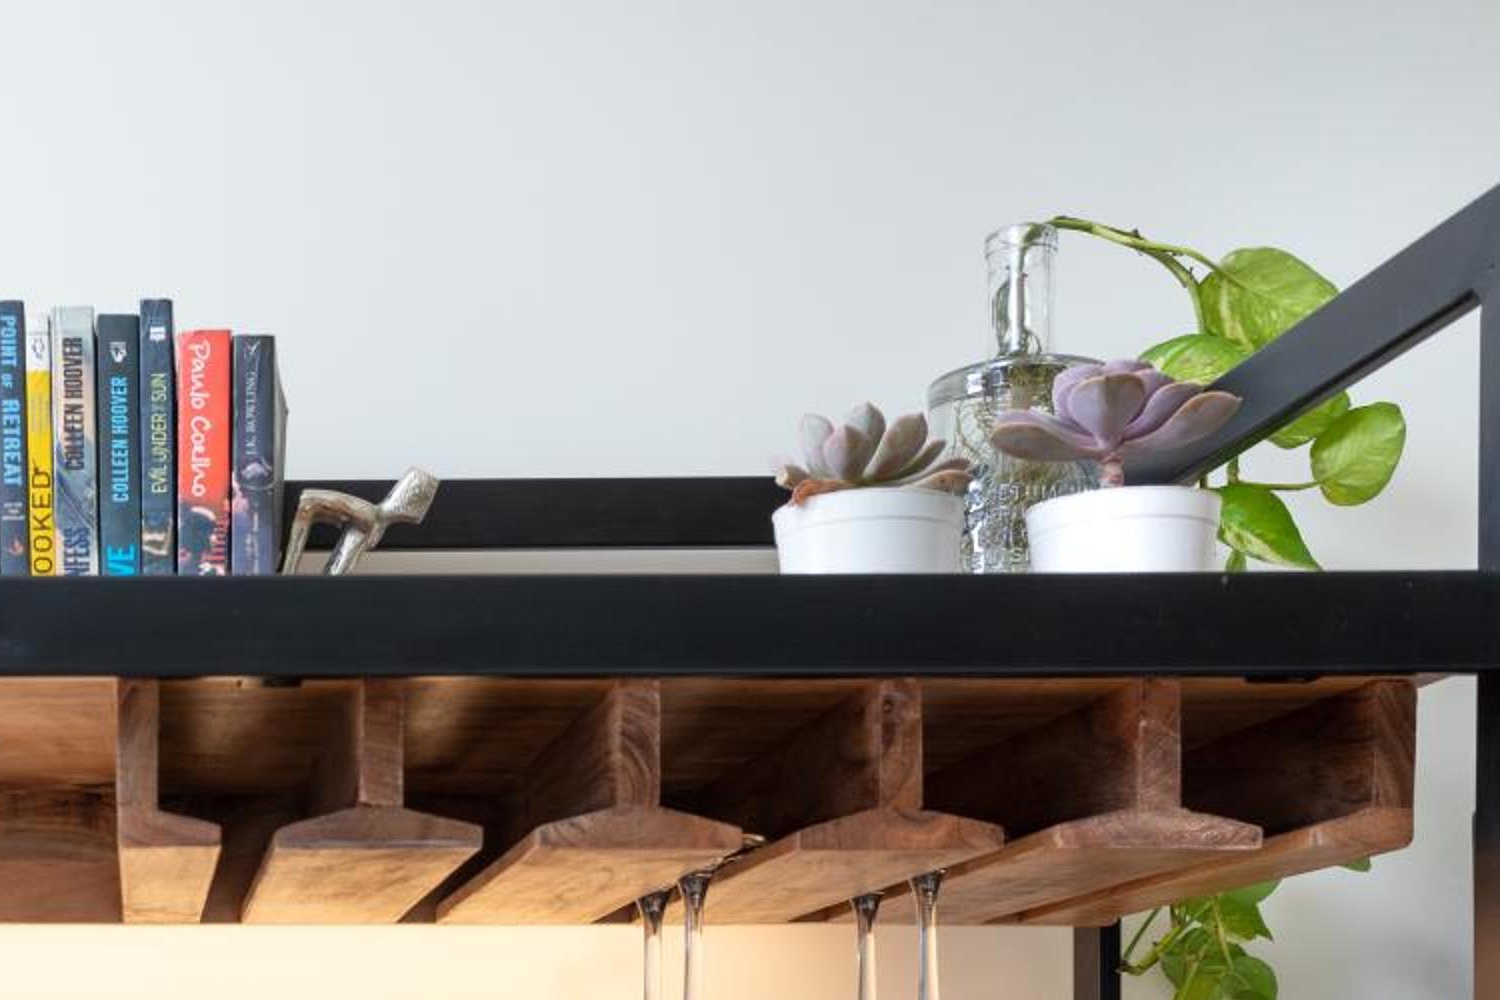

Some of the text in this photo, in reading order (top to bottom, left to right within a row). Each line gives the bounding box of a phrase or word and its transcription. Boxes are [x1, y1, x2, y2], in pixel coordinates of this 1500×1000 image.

[1, 315, 18, 367] POINT
[2, 399, 23, 486] RETREAT
[62, 337, 85, 471] COLLEEN HOOVER
[109, 377, 130, 502] COLLEEN HOOVER
[188, 339, 212, 497] Paulo Coelho
[31, 466, 53, 573] OOKED
